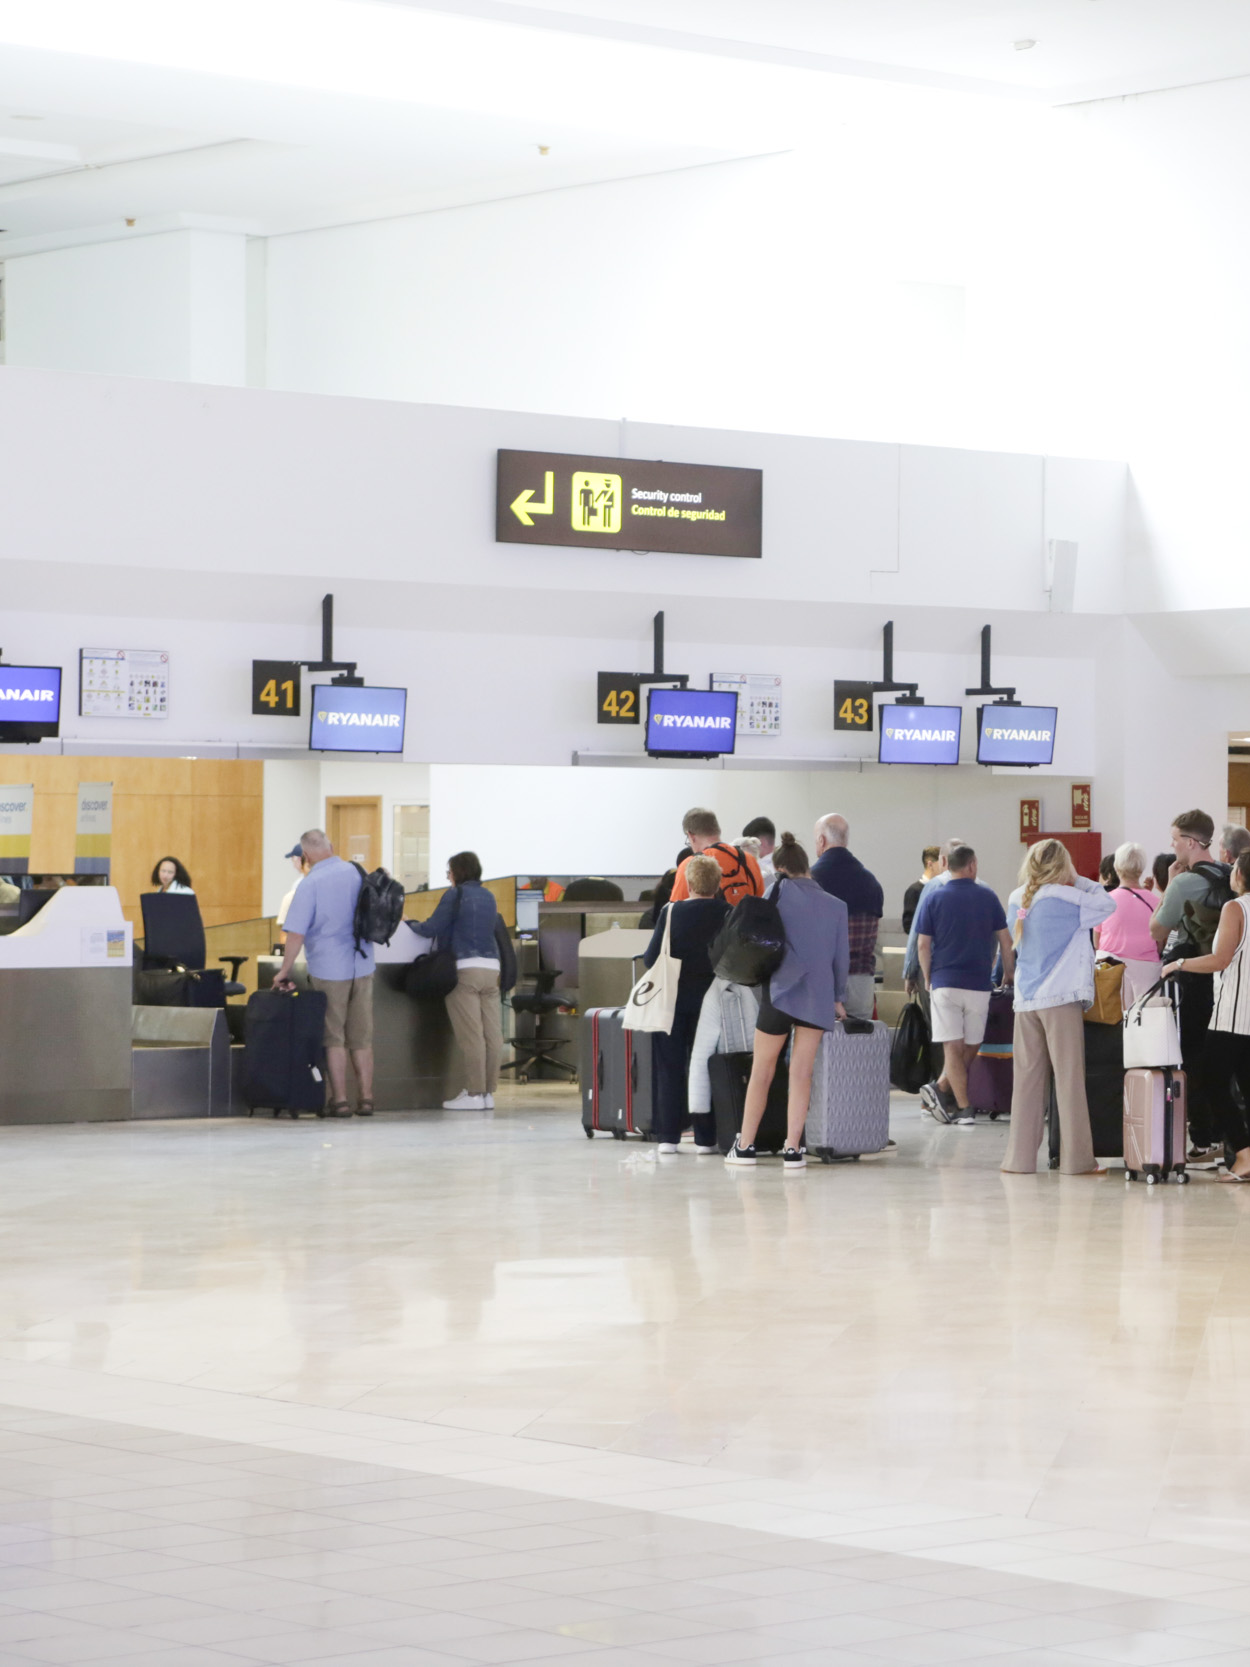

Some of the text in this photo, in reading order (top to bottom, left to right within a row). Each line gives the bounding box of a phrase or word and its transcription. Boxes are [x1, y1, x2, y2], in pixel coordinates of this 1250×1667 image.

[631, 487, 703, 503] Security control
[631, 504, 726, 521] Control de seguridad
[259, 679, 294, 708] 41
[602, 690, 636, 717] 42
[838, 698, 869, 724] 43
[327, 711, 401, 727] RYANAIR
[663, 714, 732, 729] RYANAIR
[894, 728, 956, 742] RYANAIR
[992, 728, 1051, 742] RYANAIR
